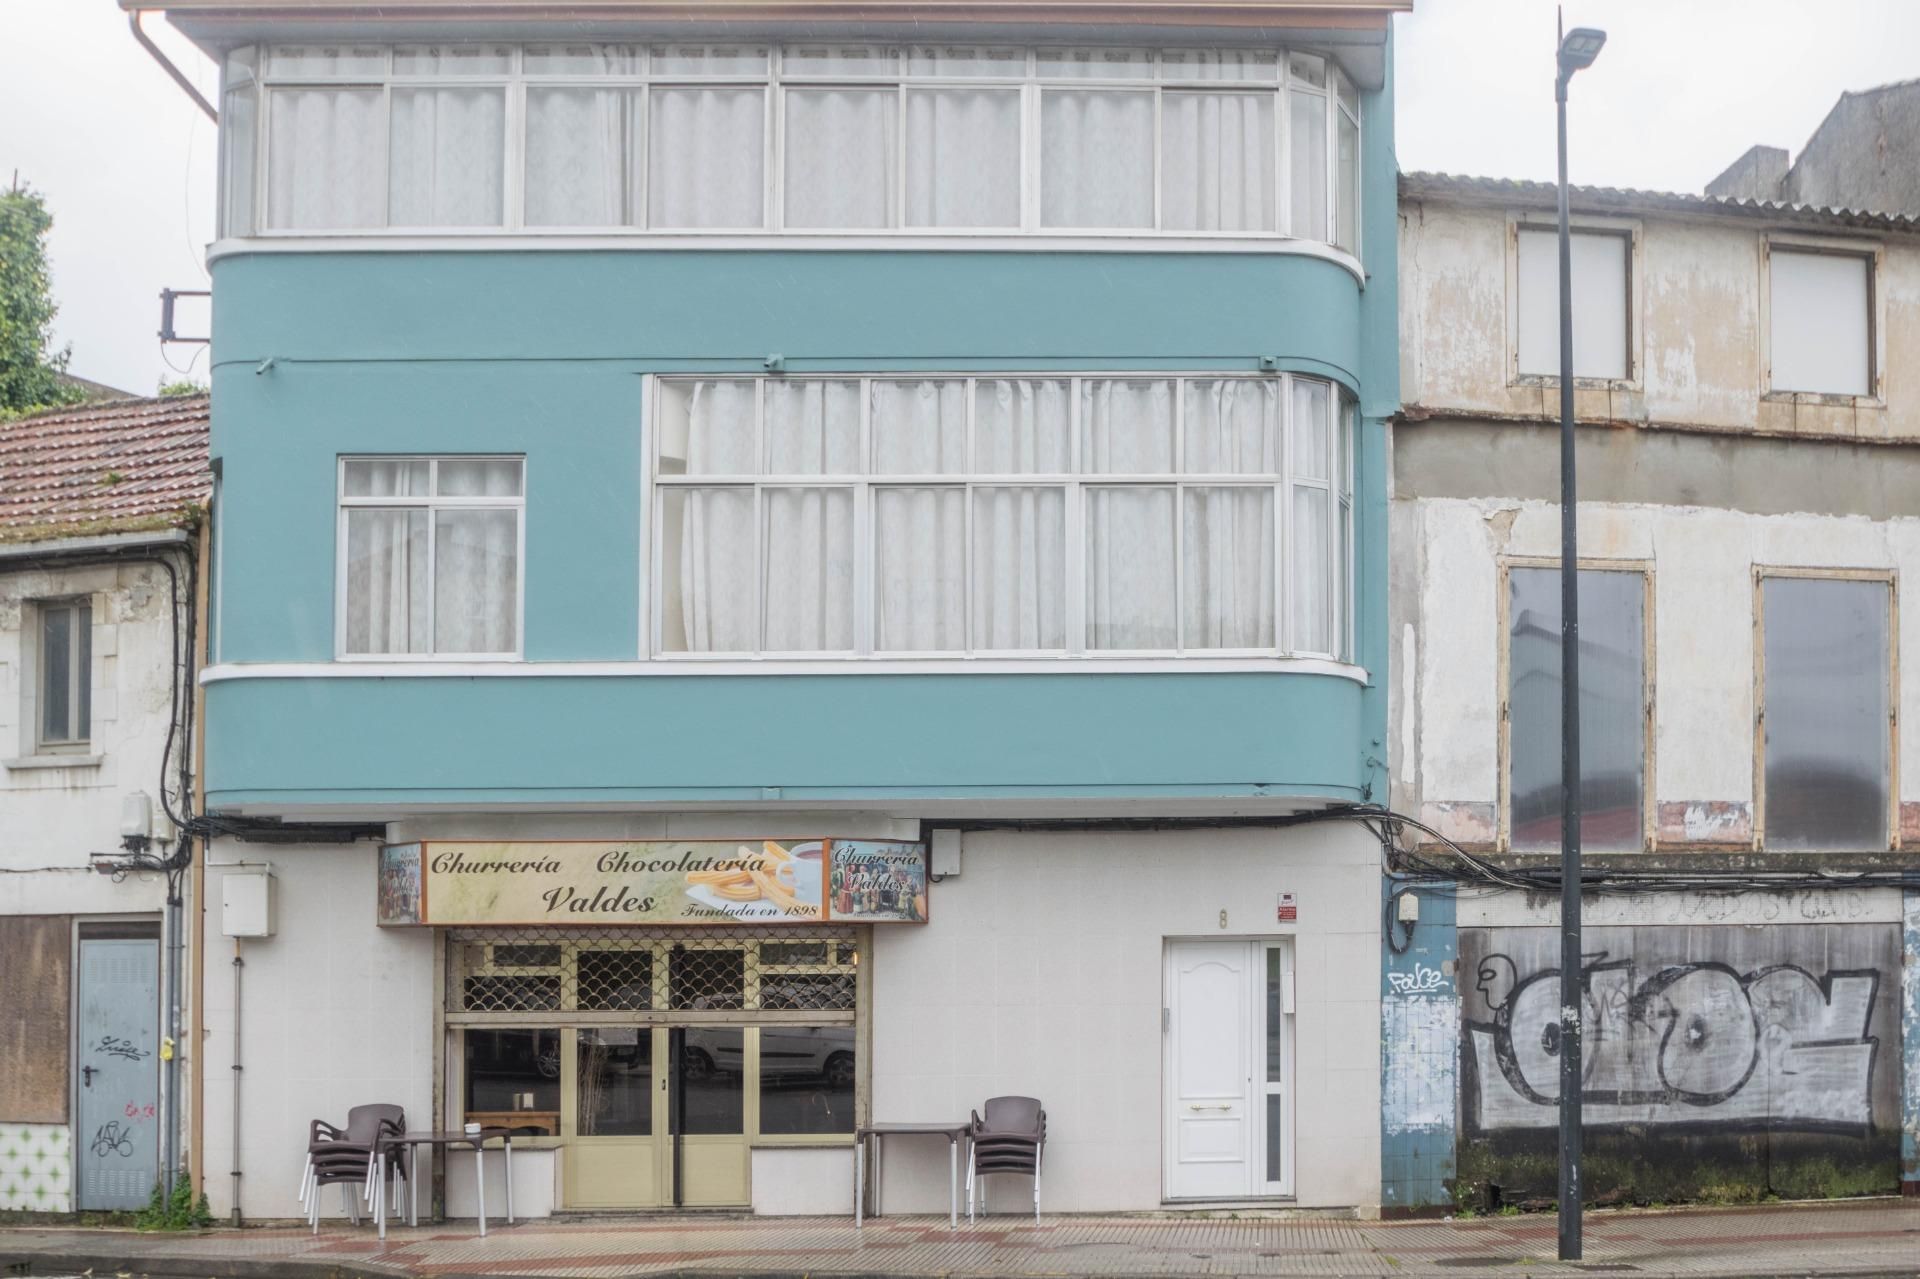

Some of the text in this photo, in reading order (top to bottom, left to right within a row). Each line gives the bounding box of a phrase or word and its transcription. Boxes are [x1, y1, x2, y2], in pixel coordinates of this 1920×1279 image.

[431, 850, 766, 874] Churrería Chocolatería
[848, 872, 906, 891] Valdes
[542, 886, 657, 913] Valdes
[680, 903, 819, 917] Fundada en 1898
[1219, 909, 1228, 929] 8
